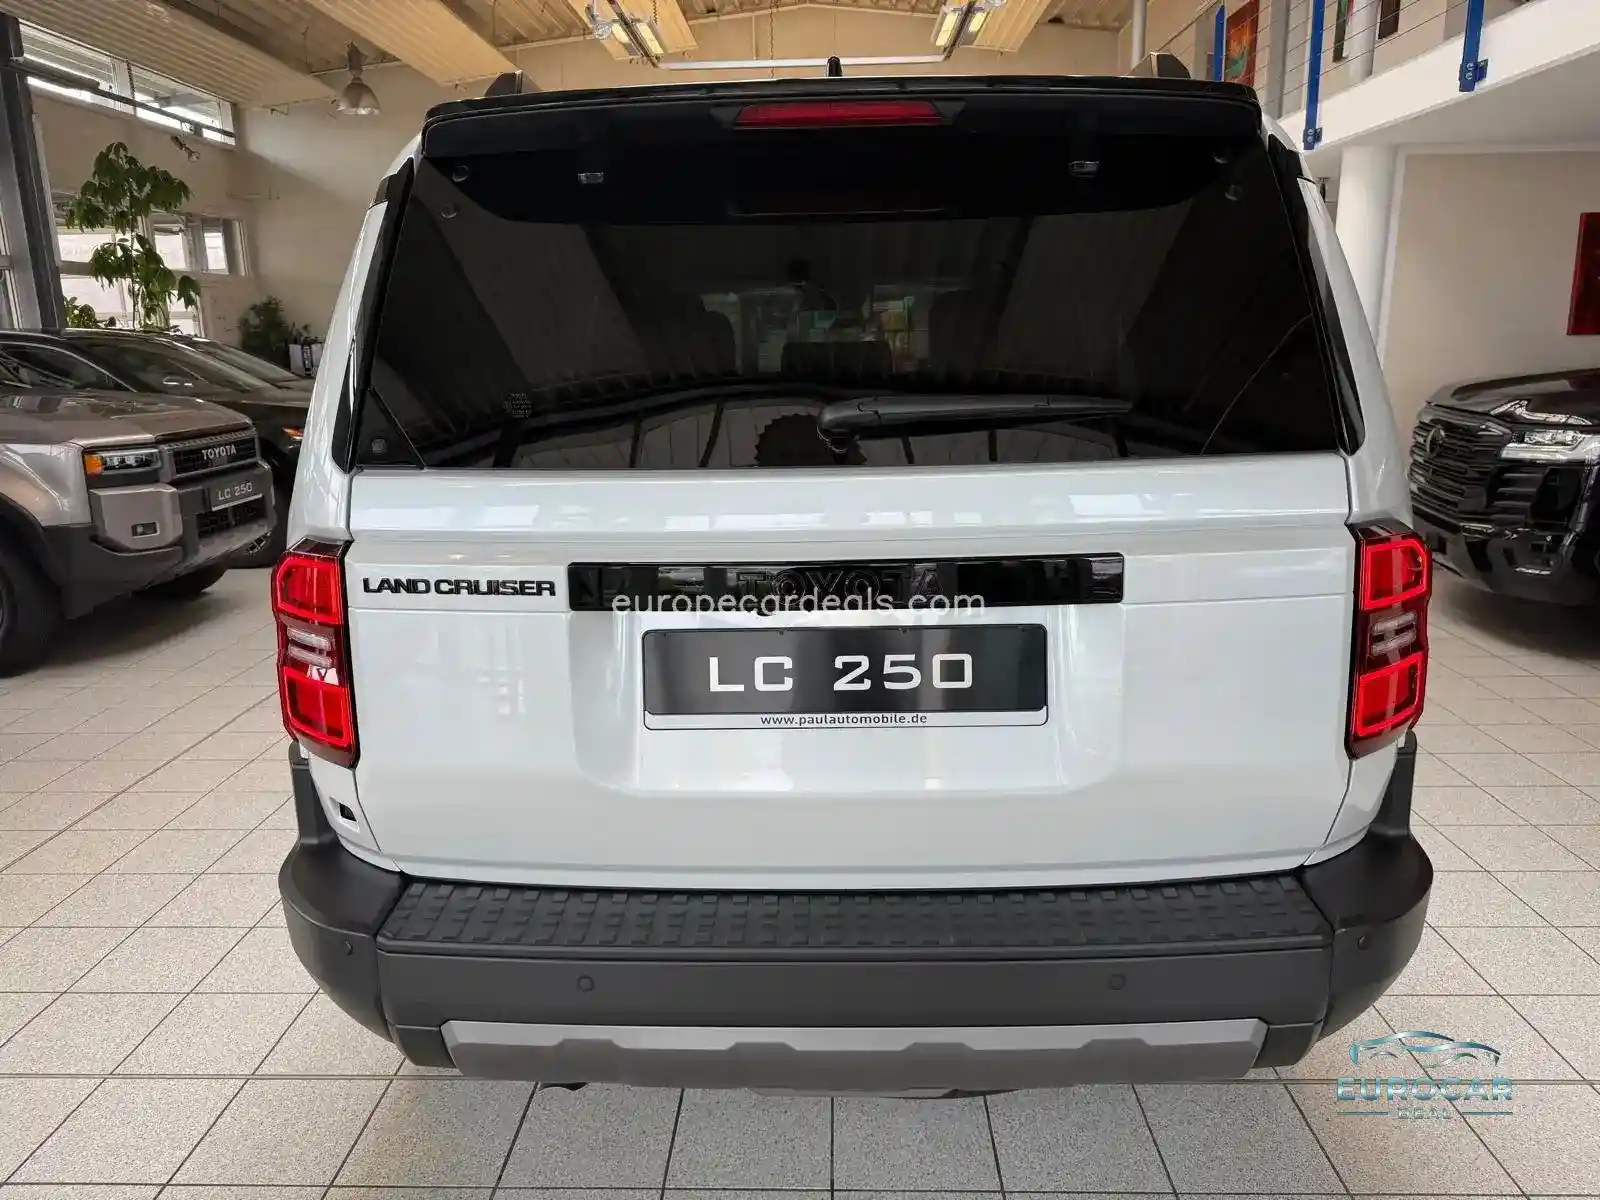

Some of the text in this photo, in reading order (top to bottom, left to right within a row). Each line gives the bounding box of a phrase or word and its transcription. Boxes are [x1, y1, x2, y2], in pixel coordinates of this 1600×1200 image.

[202, 444, 237, 460] TOYOTA
[363, 578, 556, 596] LAND CRUISER
[708, 653, 973, 693] LC 250
[760, 712, 928, 728] www.paulautomobile.de
